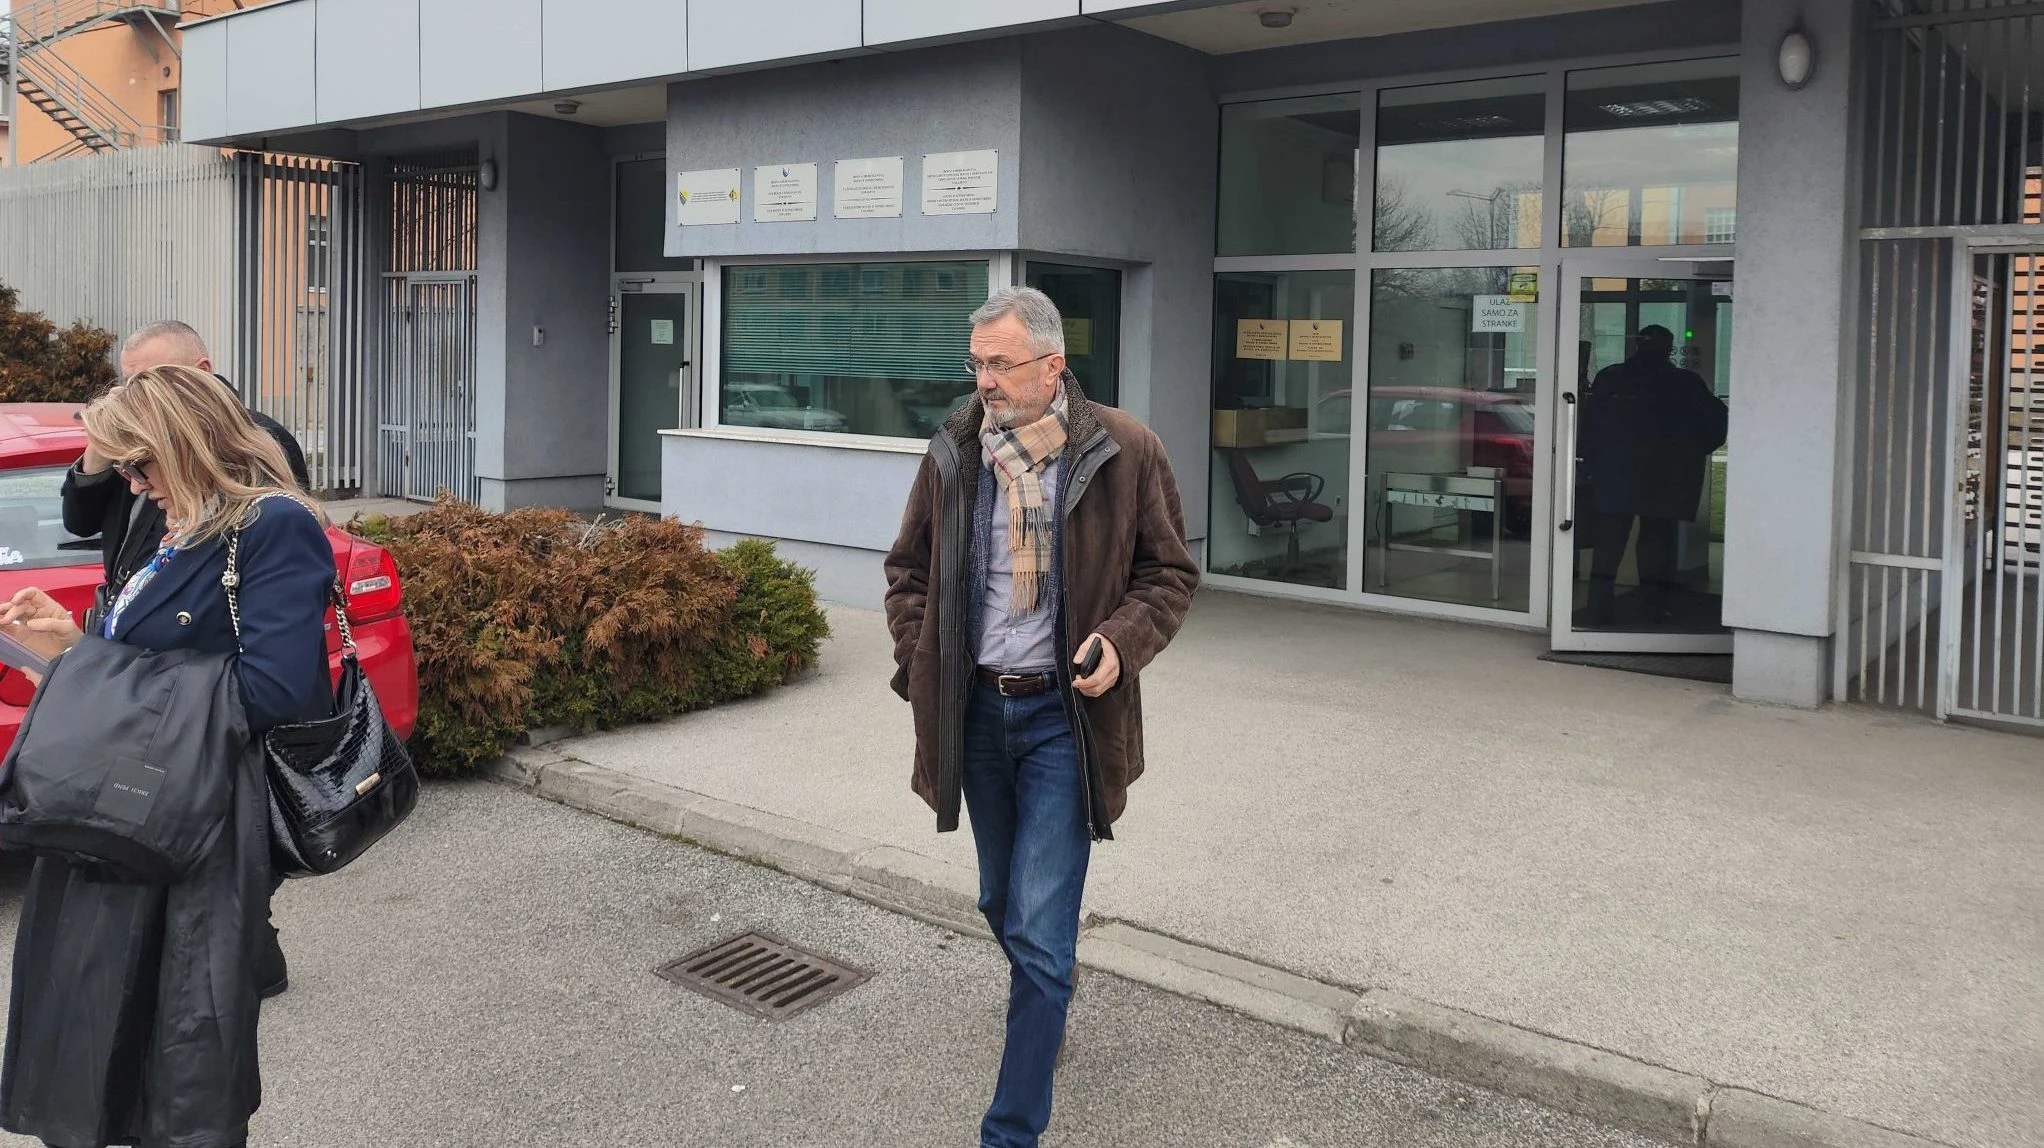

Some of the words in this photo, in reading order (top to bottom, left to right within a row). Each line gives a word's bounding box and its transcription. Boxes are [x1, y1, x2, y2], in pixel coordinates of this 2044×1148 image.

[1481, 309, 1506, 317] SAMO
[1507, 309, 1519, 317] ZA
[1481, 320, 1518, 328] STRANKE
